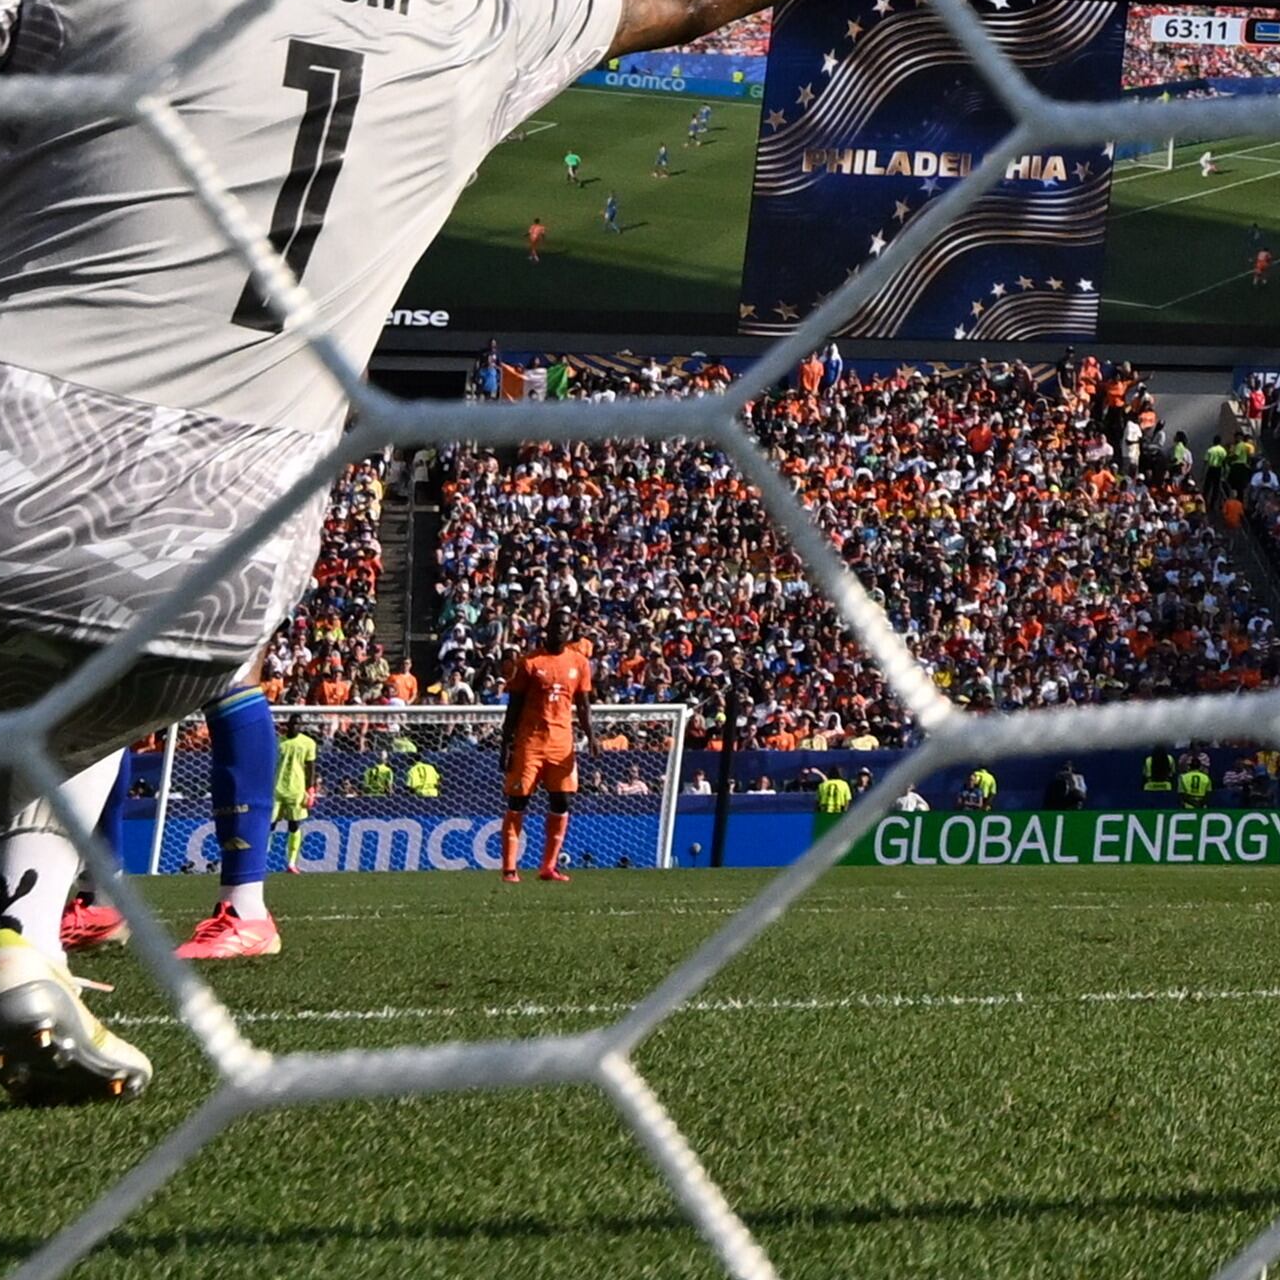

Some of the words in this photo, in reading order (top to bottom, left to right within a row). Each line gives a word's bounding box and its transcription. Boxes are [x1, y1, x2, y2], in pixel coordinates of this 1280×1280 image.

[1164, 19, 1228, 40] 63:11
[605, 72, 686, 91] aramco
[231, 39, 365, 334] 1
[874, 815, 1079, 866] GLOBAL
